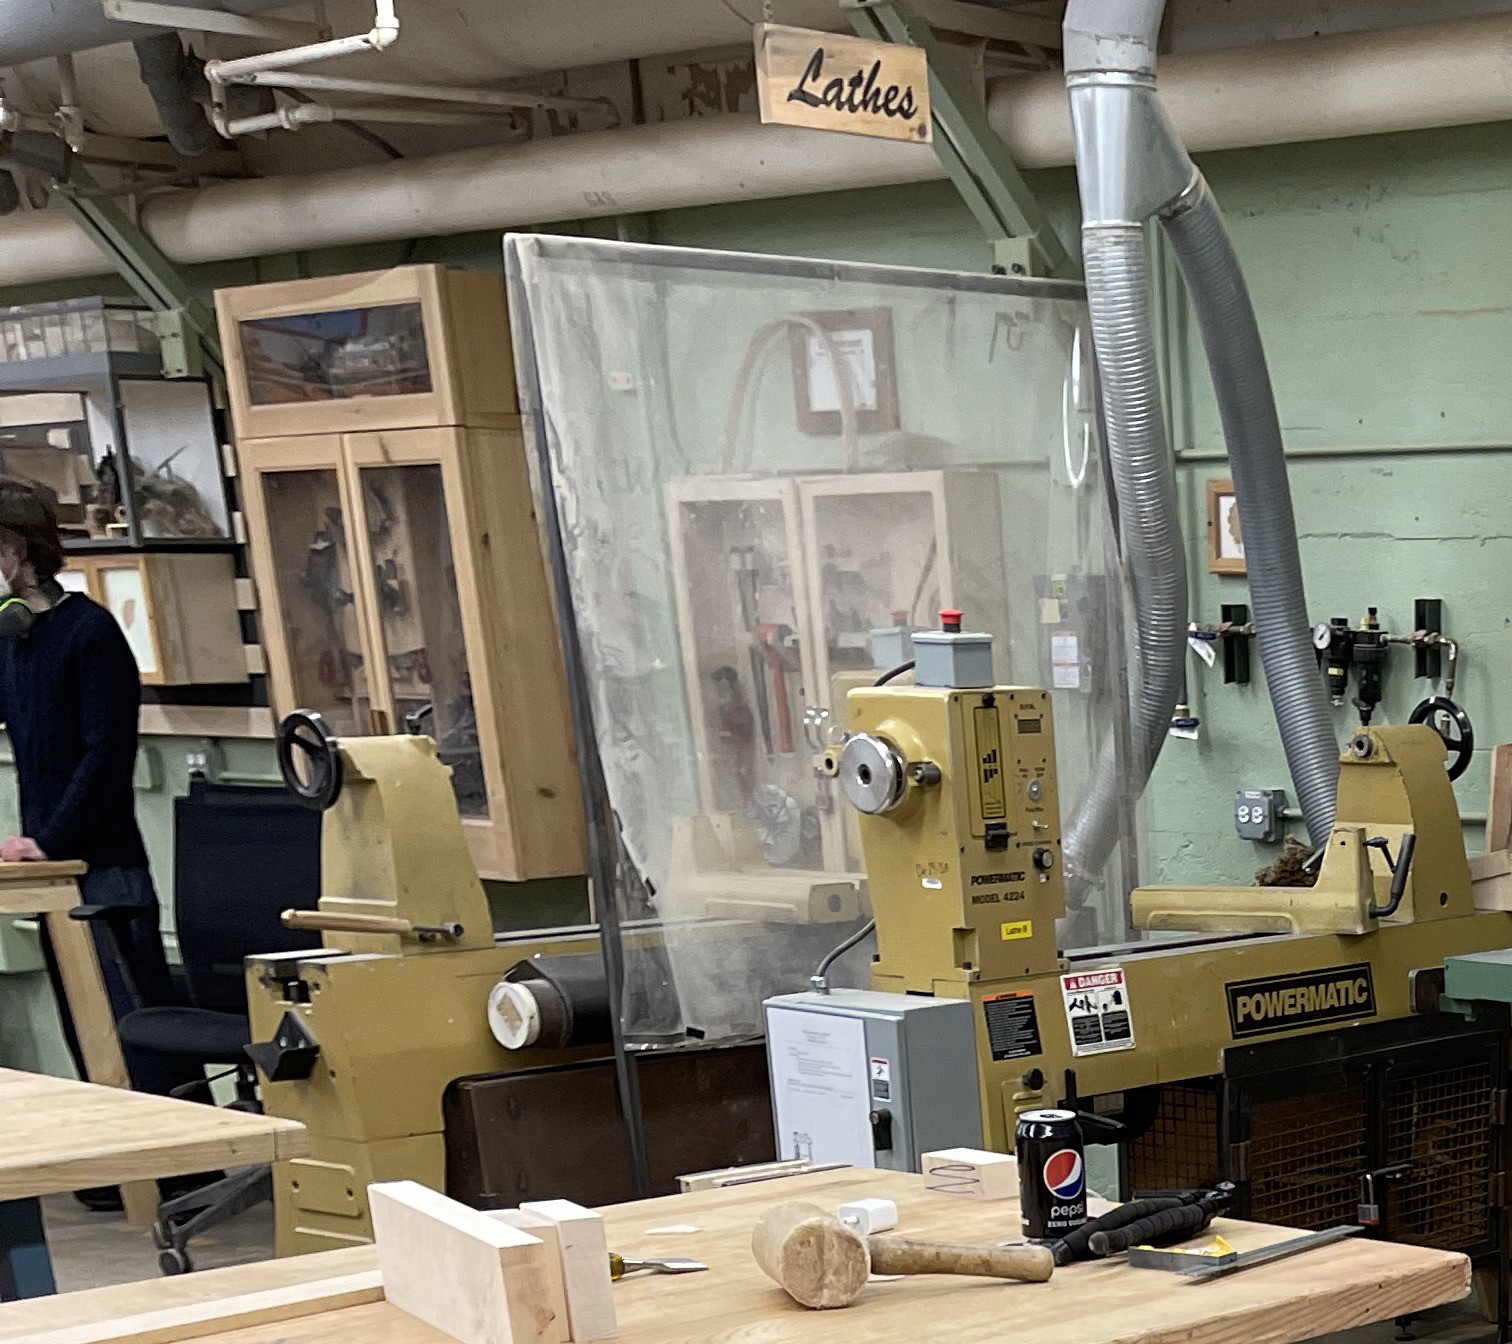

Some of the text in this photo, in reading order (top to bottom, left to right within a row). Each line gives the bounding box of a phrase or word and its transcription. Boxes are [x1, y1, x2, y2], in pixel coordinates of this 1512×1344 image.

[787, 48, 918, 119] Lathes
[1078, 972, 1119, 988] DANGER
[1236, 977, 1368, 1023] POWERMATIC
[1050, 1200, 1085, 1219] pepsi
